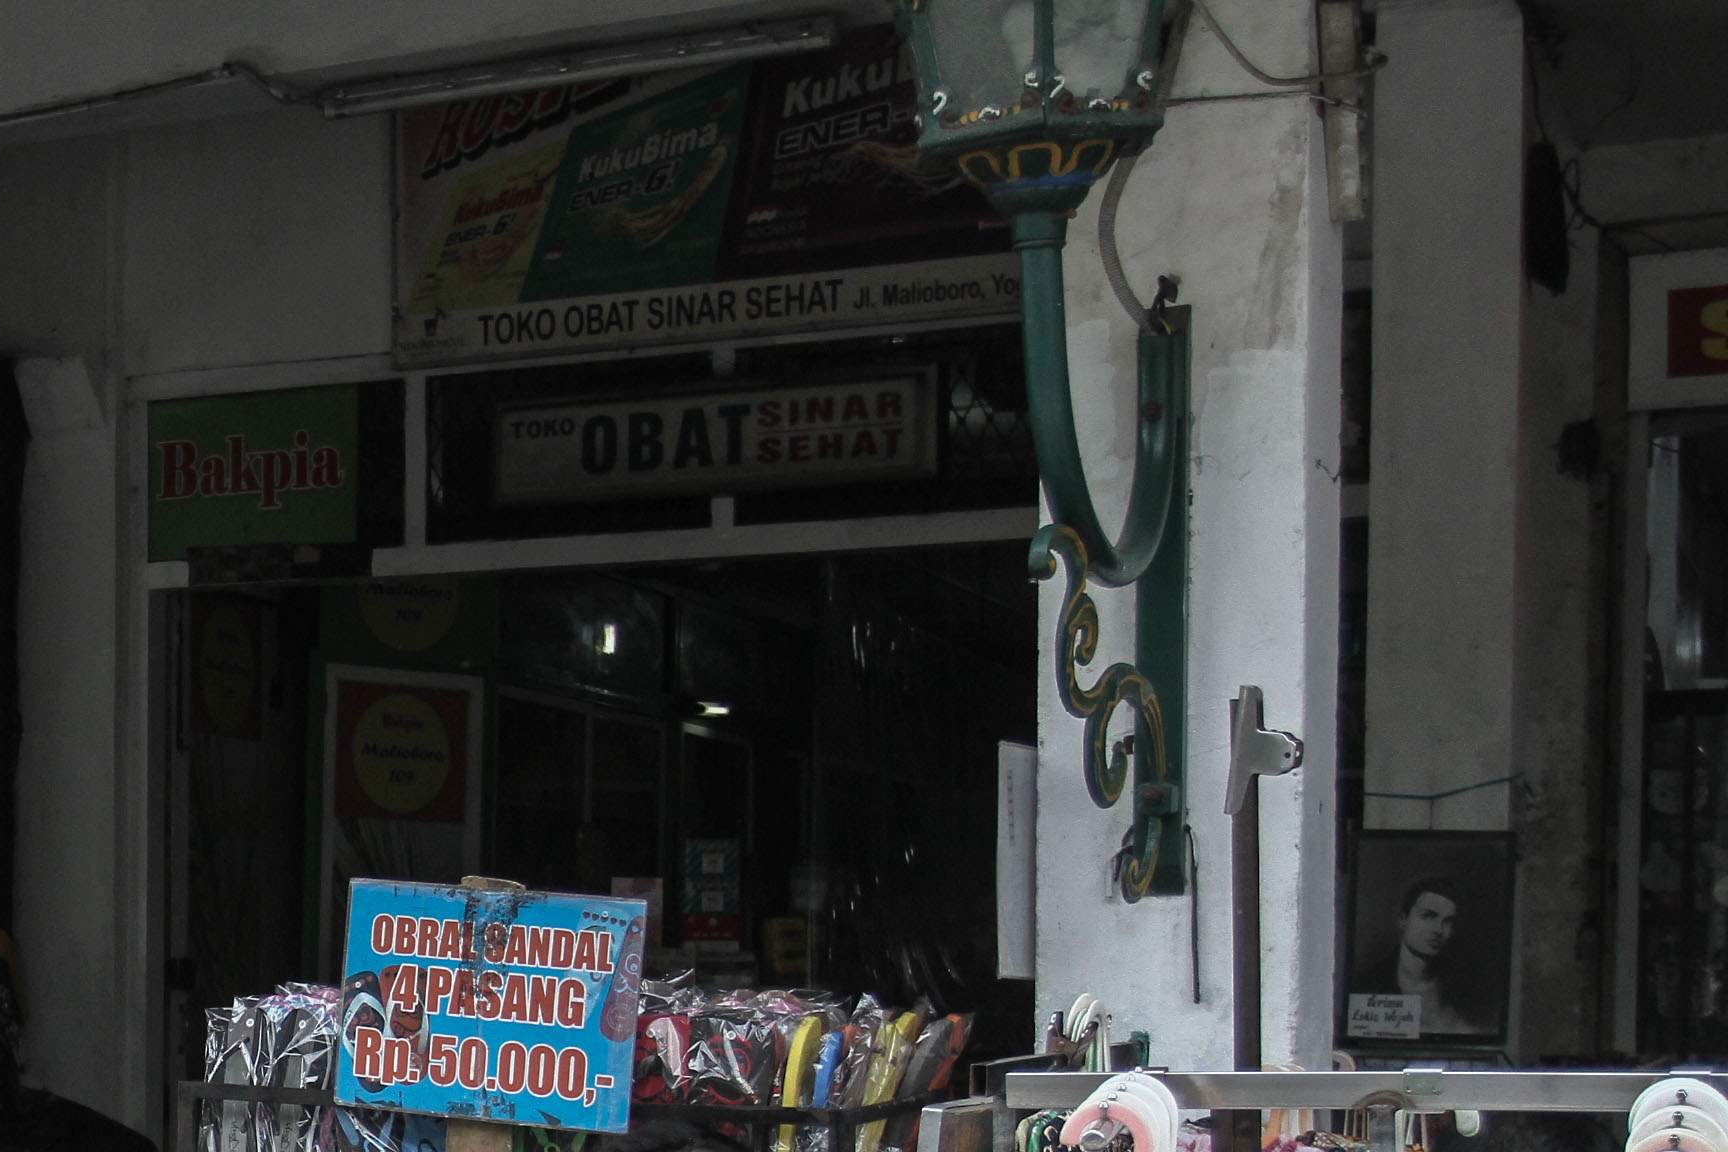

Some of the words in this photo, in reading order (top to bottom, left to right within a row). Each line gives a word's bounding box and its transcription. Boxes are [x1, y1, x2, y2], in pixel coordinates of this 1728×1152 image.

[577, 120, 720, 183] KukuBima
[478, 309, 556, 346] TOKO
[564, 299, 639, 338] OBAT
[647, 290, 737, 331] SINAR
[745, 278, 844, 321] SEHAT
[882, 279, 985, 308] Malioboro,
[511, 417, 575, 440] TOKO
[581, 404, 751, 475] OBAT
[756, 391, 904, 428] SINAR
[157, 428, 344, 511] Bakpia
[756, 428, 905, 464] SEHAT
[371, 912, 478, 960] OBRAL
[483, 921, 615, 974] SANDAL
[391, 962, 419, 1013] 4
[425, 965, 587, 1029] PASANG
[353, 1025, 421, 1087] Rp.
[427, 1033, 616, 1108] 50.000,-
